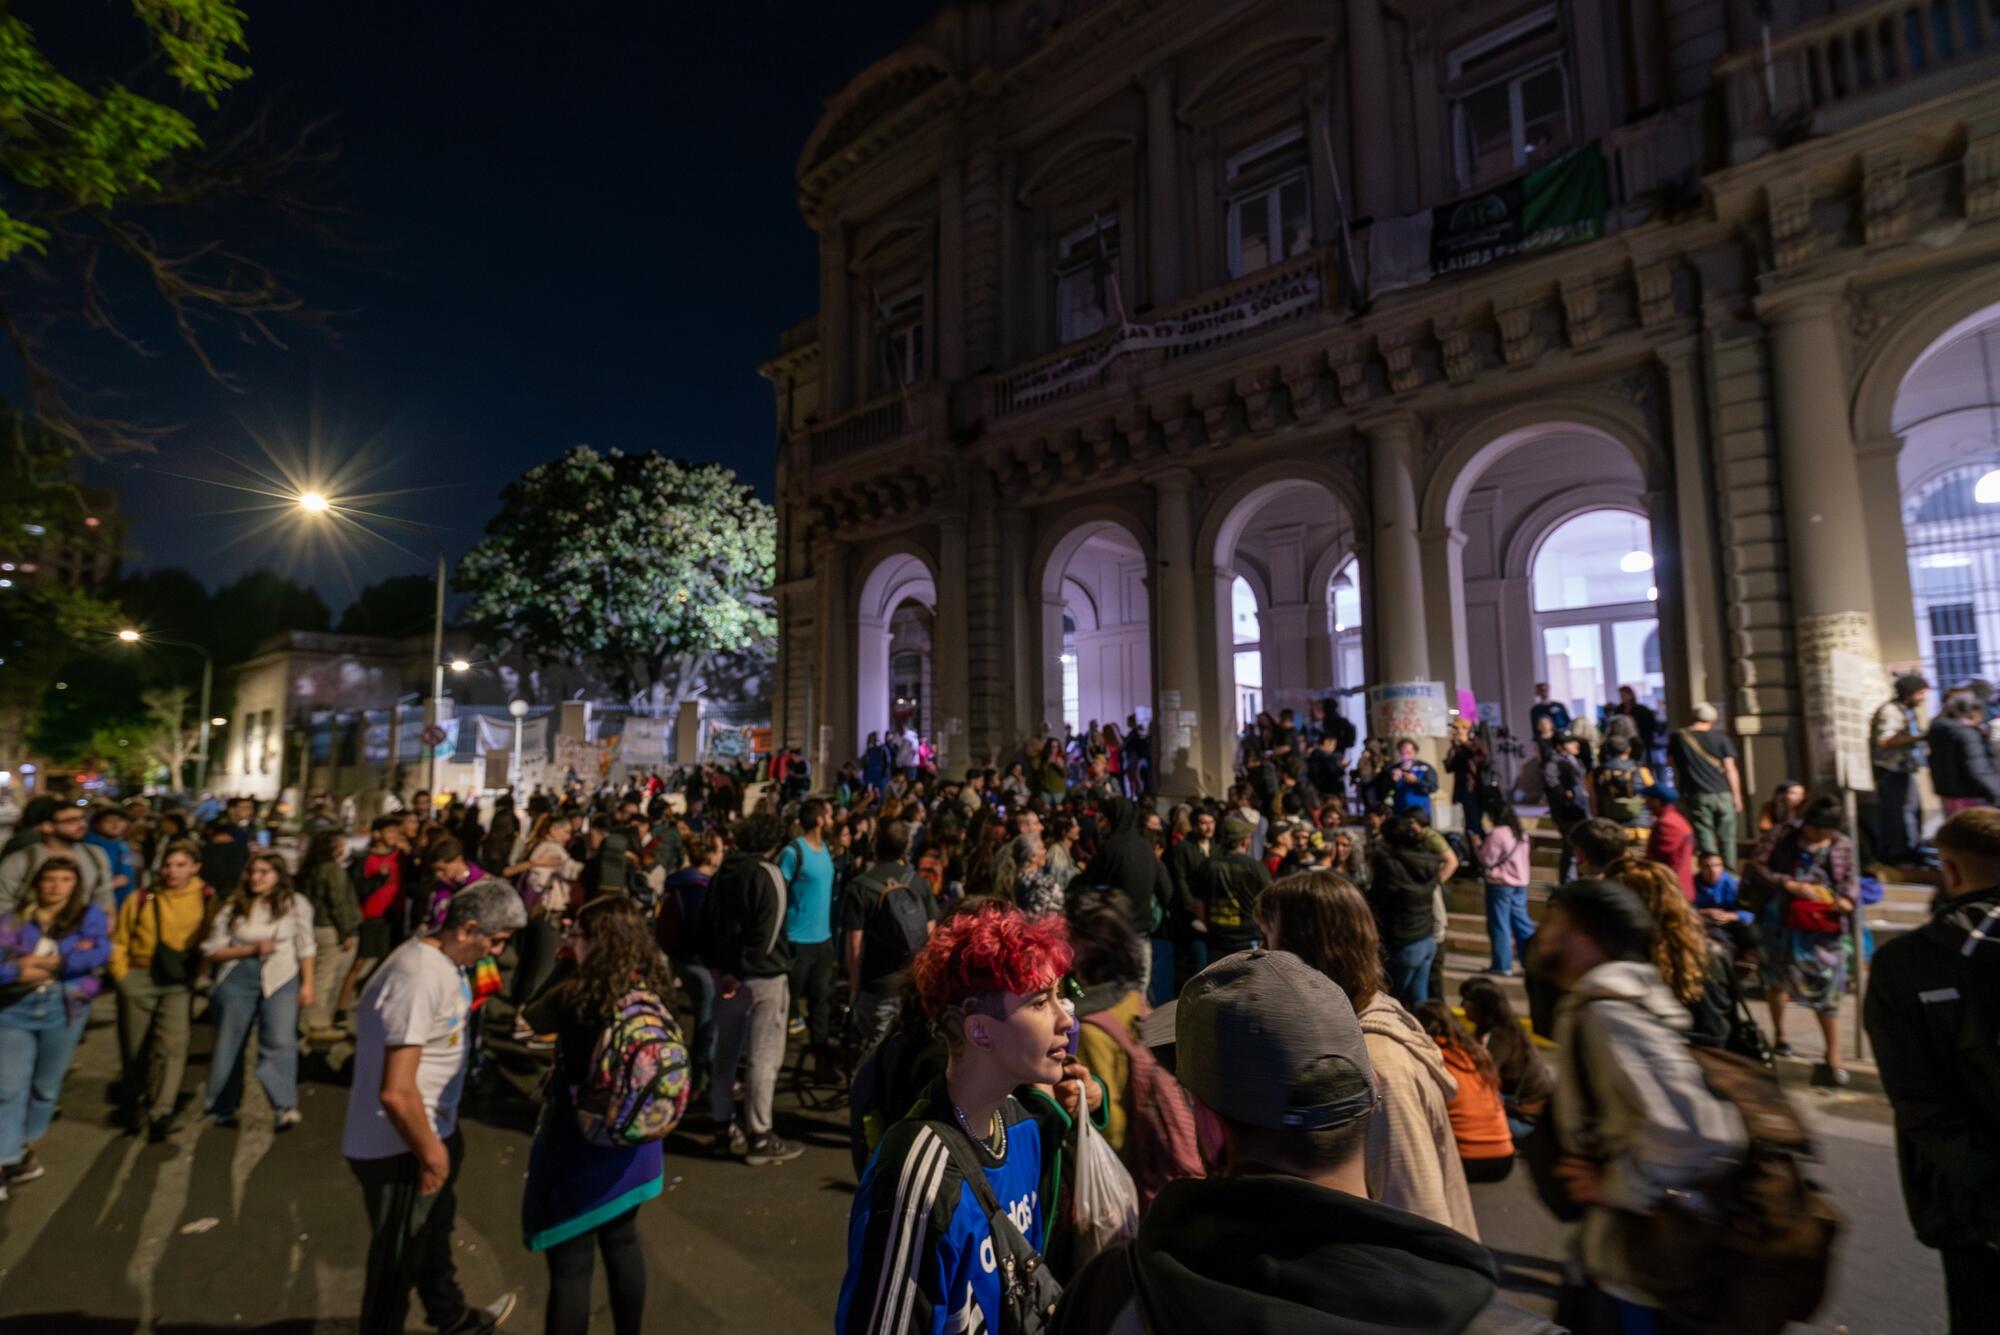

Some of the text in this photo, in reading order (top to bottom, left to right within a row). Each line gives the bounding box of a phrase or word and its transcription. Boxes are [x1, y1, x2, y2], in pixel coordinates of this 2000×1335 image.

[1179, 308, 1247, 336] JUSTICIA
[1251, 284, 1312, 316] SOCIAL
[980, 1194, 1032, 1274] adas
